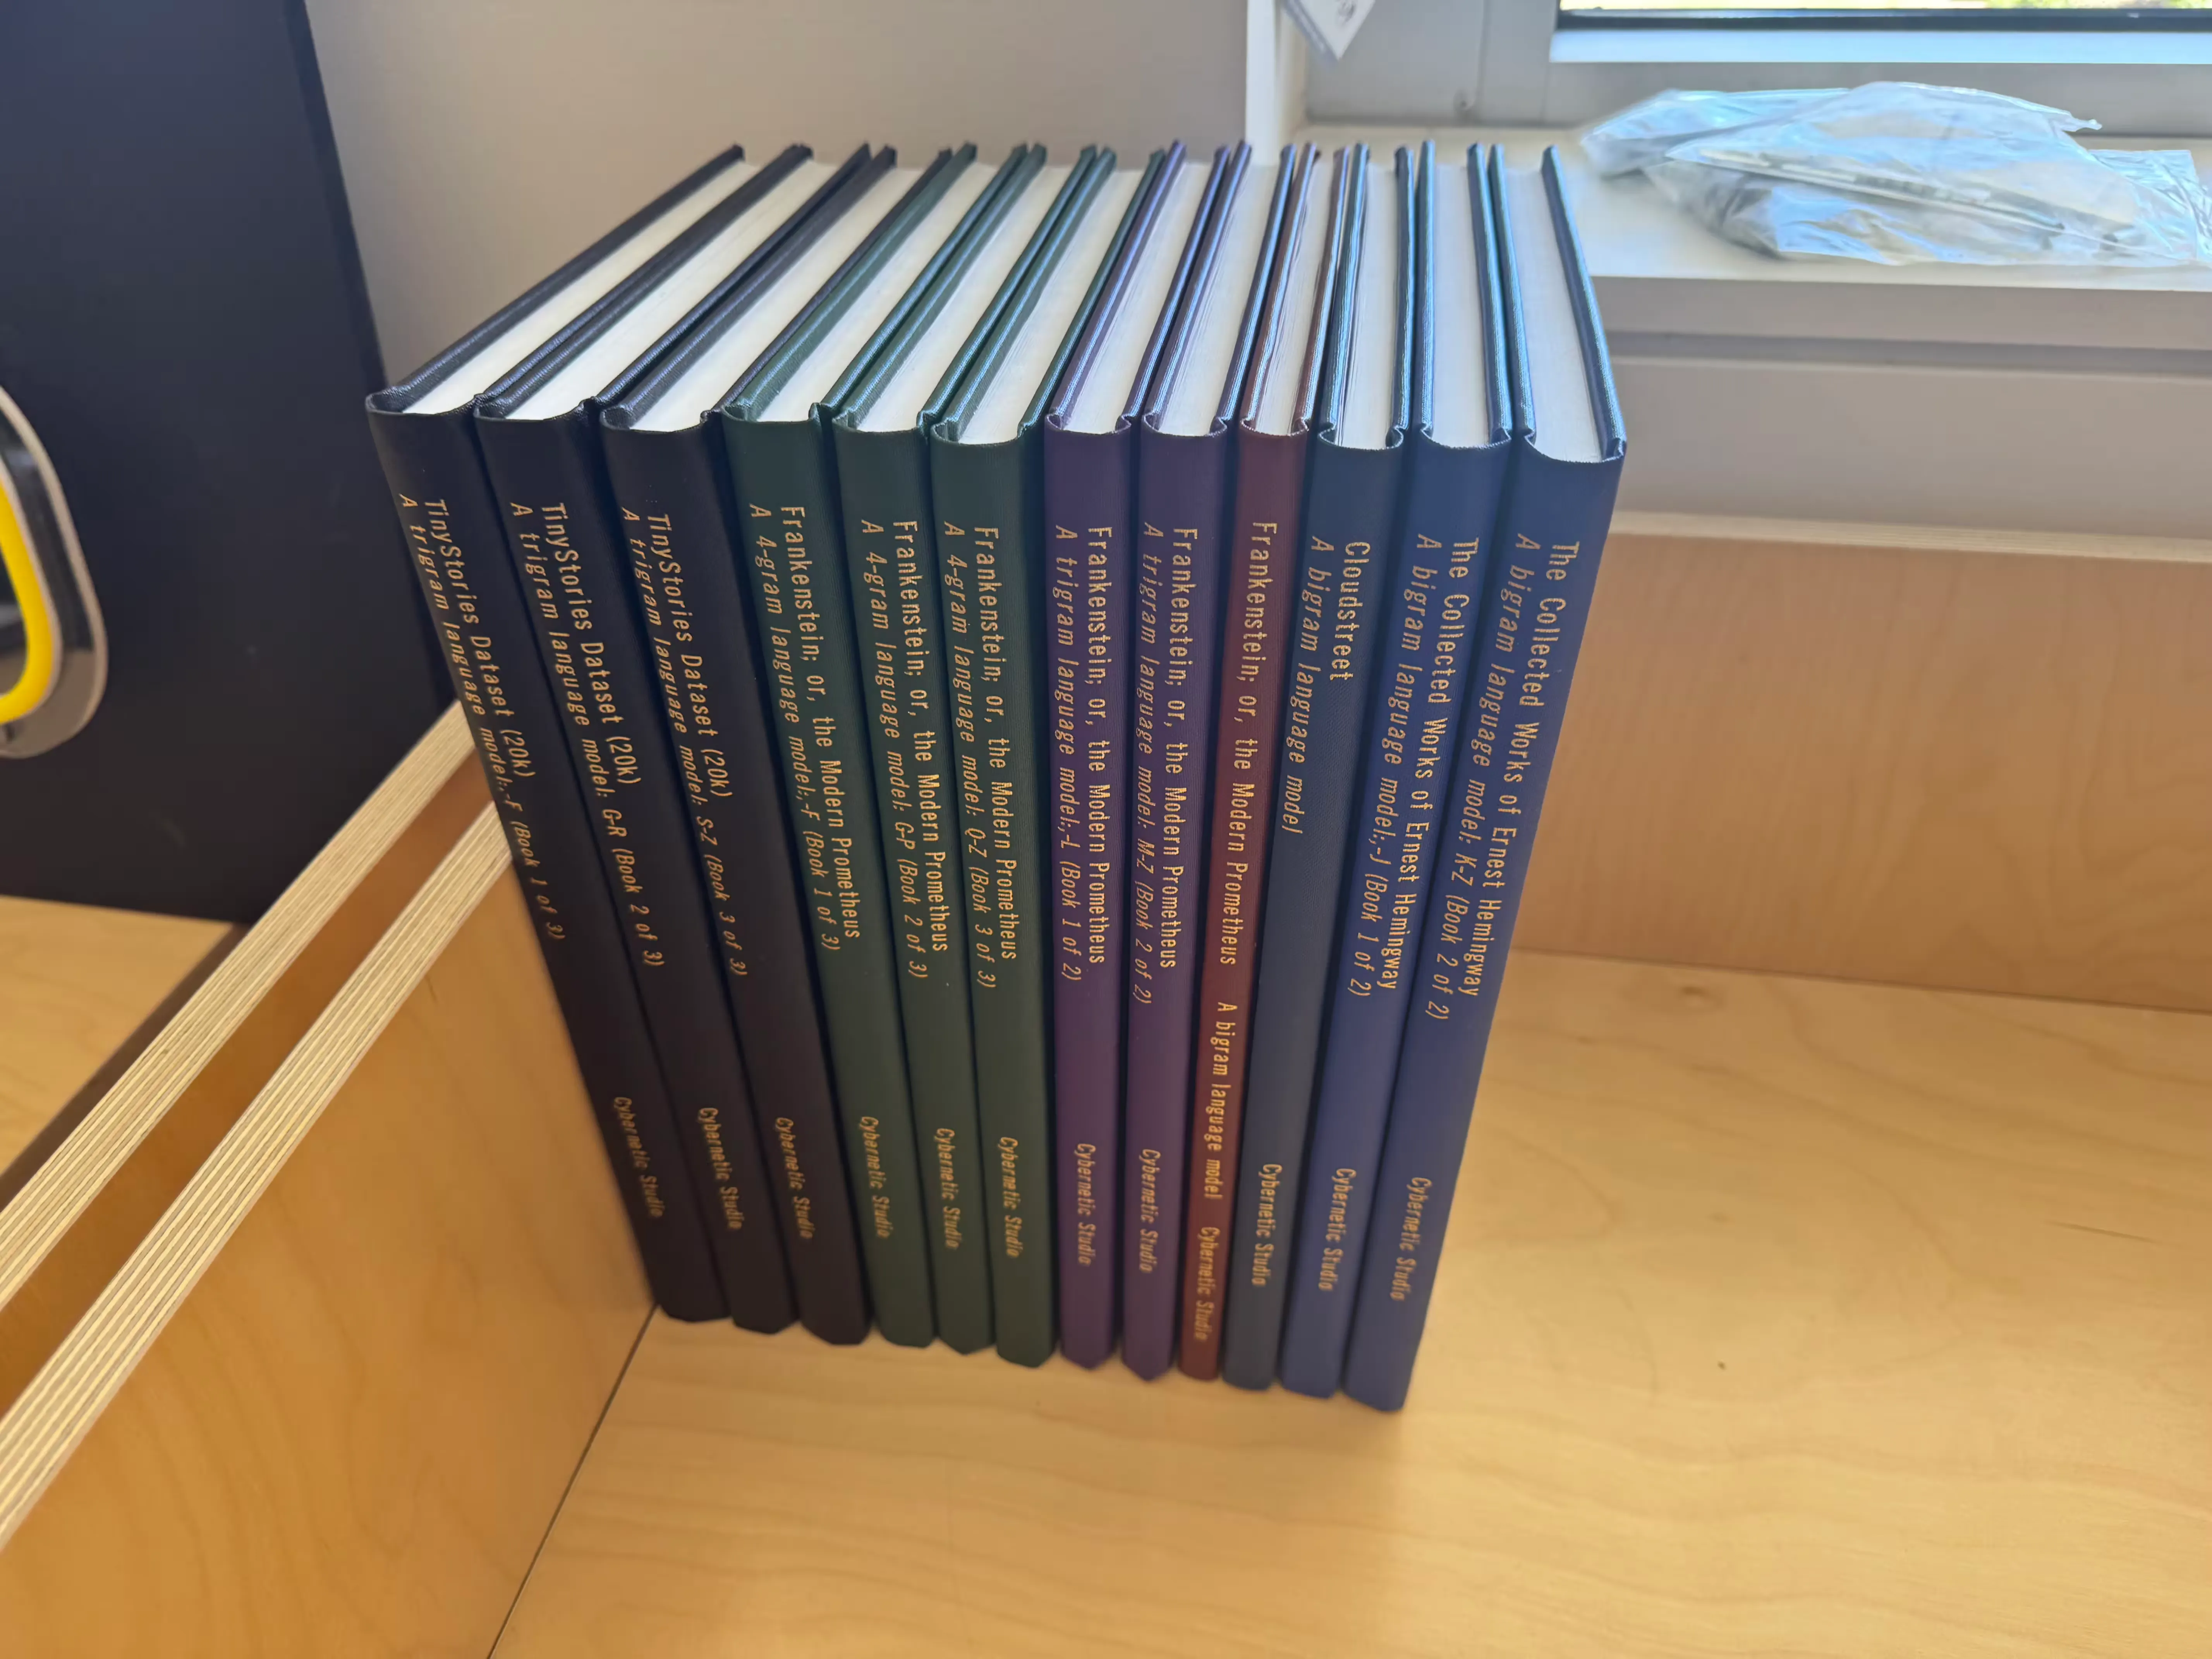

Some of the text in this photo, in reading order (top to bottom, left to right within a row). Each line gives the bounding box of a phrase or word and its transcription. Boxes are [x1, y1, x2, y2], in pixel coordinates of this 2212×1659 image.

[749, 503, 772, 518] A
[1055, 525, 1078, 539] A
[1416, 533, 1443, 549] A
[755, 535, 783, 615] 4-gram
[1052, 557, 1079, 646] trigram
[1329, 541, 1371, 681] Cloudstreet
[1401, 565, 1439, 651] bigram
[424, 499, 536, 777] TinyStories Dataset (20k)
[541, 502, 642, 784] TinyStories Dataset (20k)
[647, 514, 733, 797] TinyStories Dataset (20k)
[770, 627, 800, 723] language
[1281, 536, 1335, 834] A bigram language model
[510, 502, 665, 966] A trigram language model: G-R (Book 2 of 3)
[621, 507, 748, 976] A trigram language model: S-Z (Book 3 of 3)
[780, 506, 861, 938] Frankenstein; or, the Modern Prometheus
[861, 519, 929, 979] A 4-gram language model: G-P (Book 2 of 3)
[893, 520, 951, 952] Frankenstein; or, the Modern Prometheus
[944, 521, 997, 988] A 4-gram language model: Q-Z (Book 3 of 3)
[974, 527, 1020, 960] Frankenstein; or, the Modern Prometheus
[1054, 657, 1080, 755] language
[1084, 526, 1113, 963] Frankenstein; or, the Modern Prometheus
[1133, 522, 1164, 1004] A trigram language model: M-Z (Book 2 of 2)
[1159, 528, 1198, 969] Frankenstein; or, the Modern Prometheus
[1220, 522, 1278, 965] Frankenstein; or, the Modern Prometheus
[1376, 537, 1480, 989] The Collected Works of Ernest Hemingway
[1381, 663, 1424, 765] language
[1425, 533, 1541, 1020] A bigram language model: K-Z (Book 2 of 2)
[1457, 541, 1580, 997] The Collected Works of Ernest Hemingway
[802, 830, 830, 878] (Book
[813, 888, 833, 897] 1
[1059, 860, 1081, 908] (Book
[1360, 873, 1389, 923] (Book
[817, 906, 837, 925] of
[821, 933, 841, 951] 3)
[1061, 962, 1082, 981] 2)
[1062, 918, 1082, 928] 1
[1062, 936, 1082, 957] of
[1353, 951, 1376, 972] of
[1357, 932, 1380, 943] 1
[1347, 978, 1372, 997] 2)
[1204, 1001, 1238, 1199] A bigram language model
[698, 1108, 743, 1229] Cybernetic Studio
[934, 1128, 962, 1248] Cybernetic Studio
[1074, 1143, 1097, 1265] Cybernetic Studio
[1251, 1164, 1283, 1286] Cybernetic Studio
[1318, 1168, 1357, 1291] Cybernetic Studio
